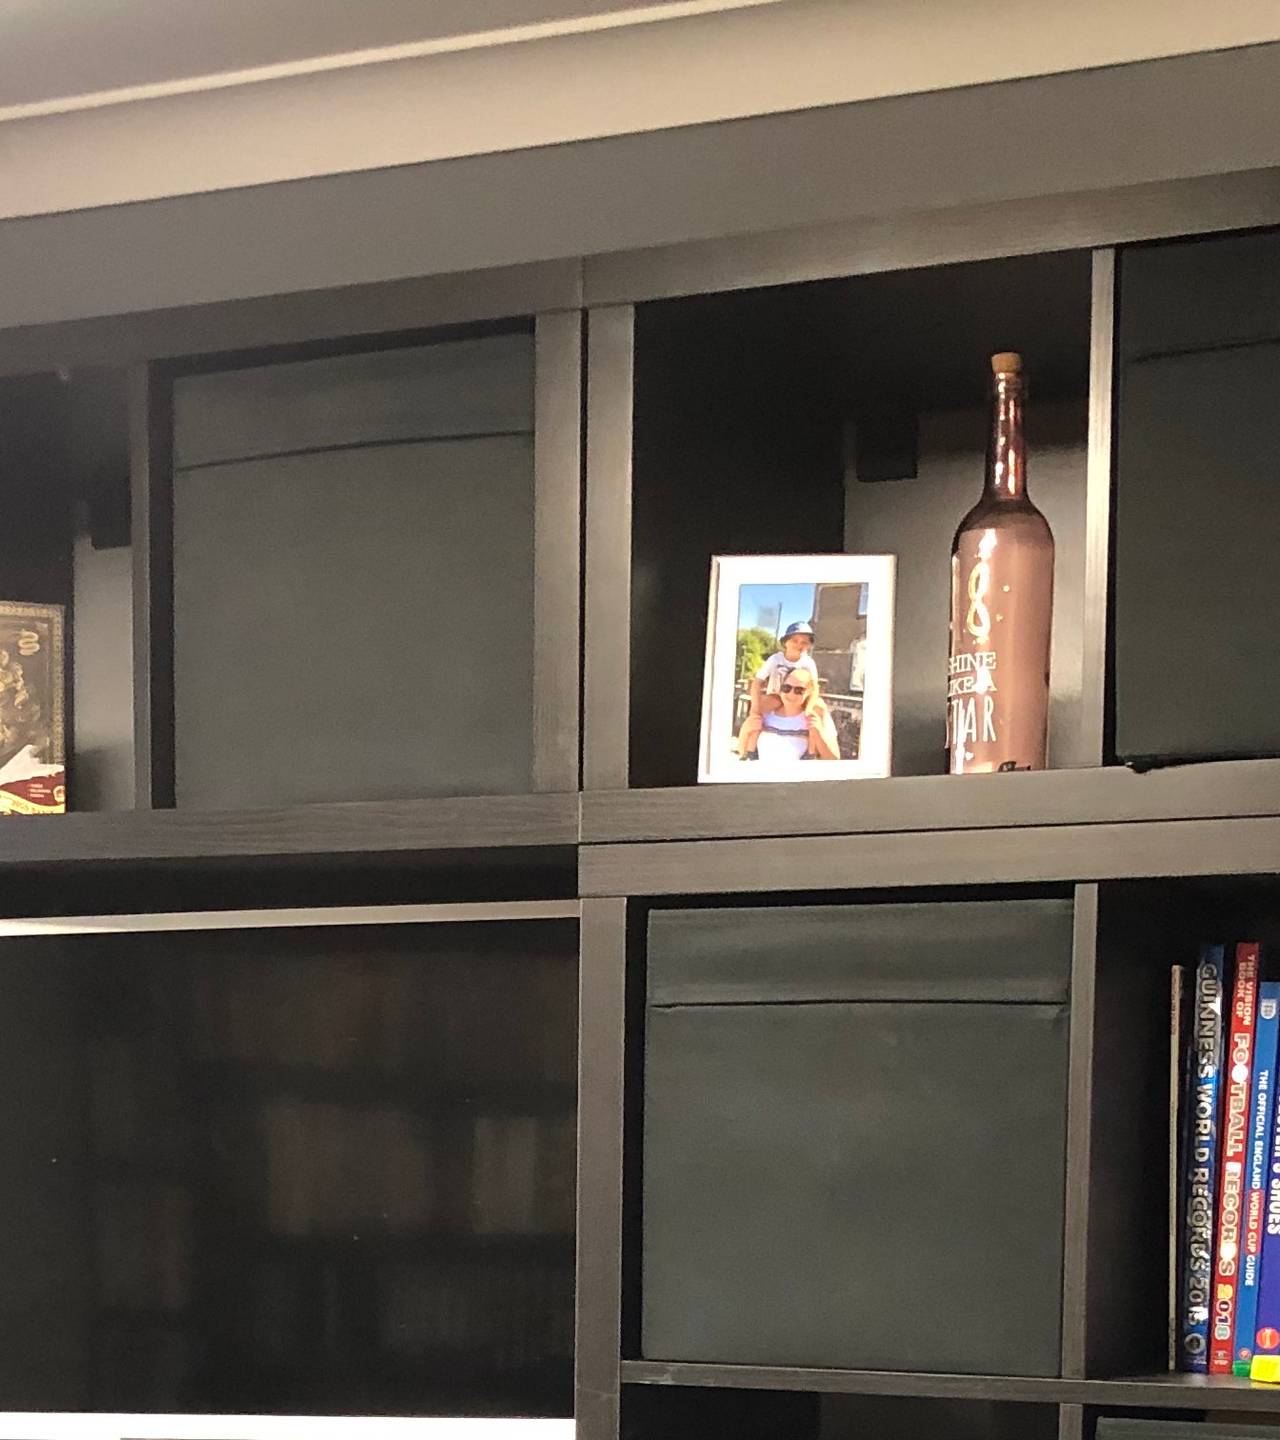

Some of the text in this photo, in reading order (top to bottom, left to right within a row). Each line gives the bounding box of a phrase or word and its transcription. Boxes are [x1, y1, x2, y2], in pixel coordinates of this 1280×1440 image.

[948, 677, 975, 697] IKE
[949, 652, 996, 673] HINE
[945, 696, 996, 748] TAR
[1235, 961, 1248, 1018] BOOK OF
[1242, 954, 1256, 1026] THE VISION
[1188, 963, 1218, 1272] GUINNESS WORLD RECORDS
[1215, 1032, 1251, 1340] FOOTBALL RECORDS 2018
[1244, 1070, 1269, 1287] THE OFFICIAL ENGLAND WORLD CUP GUIDE
